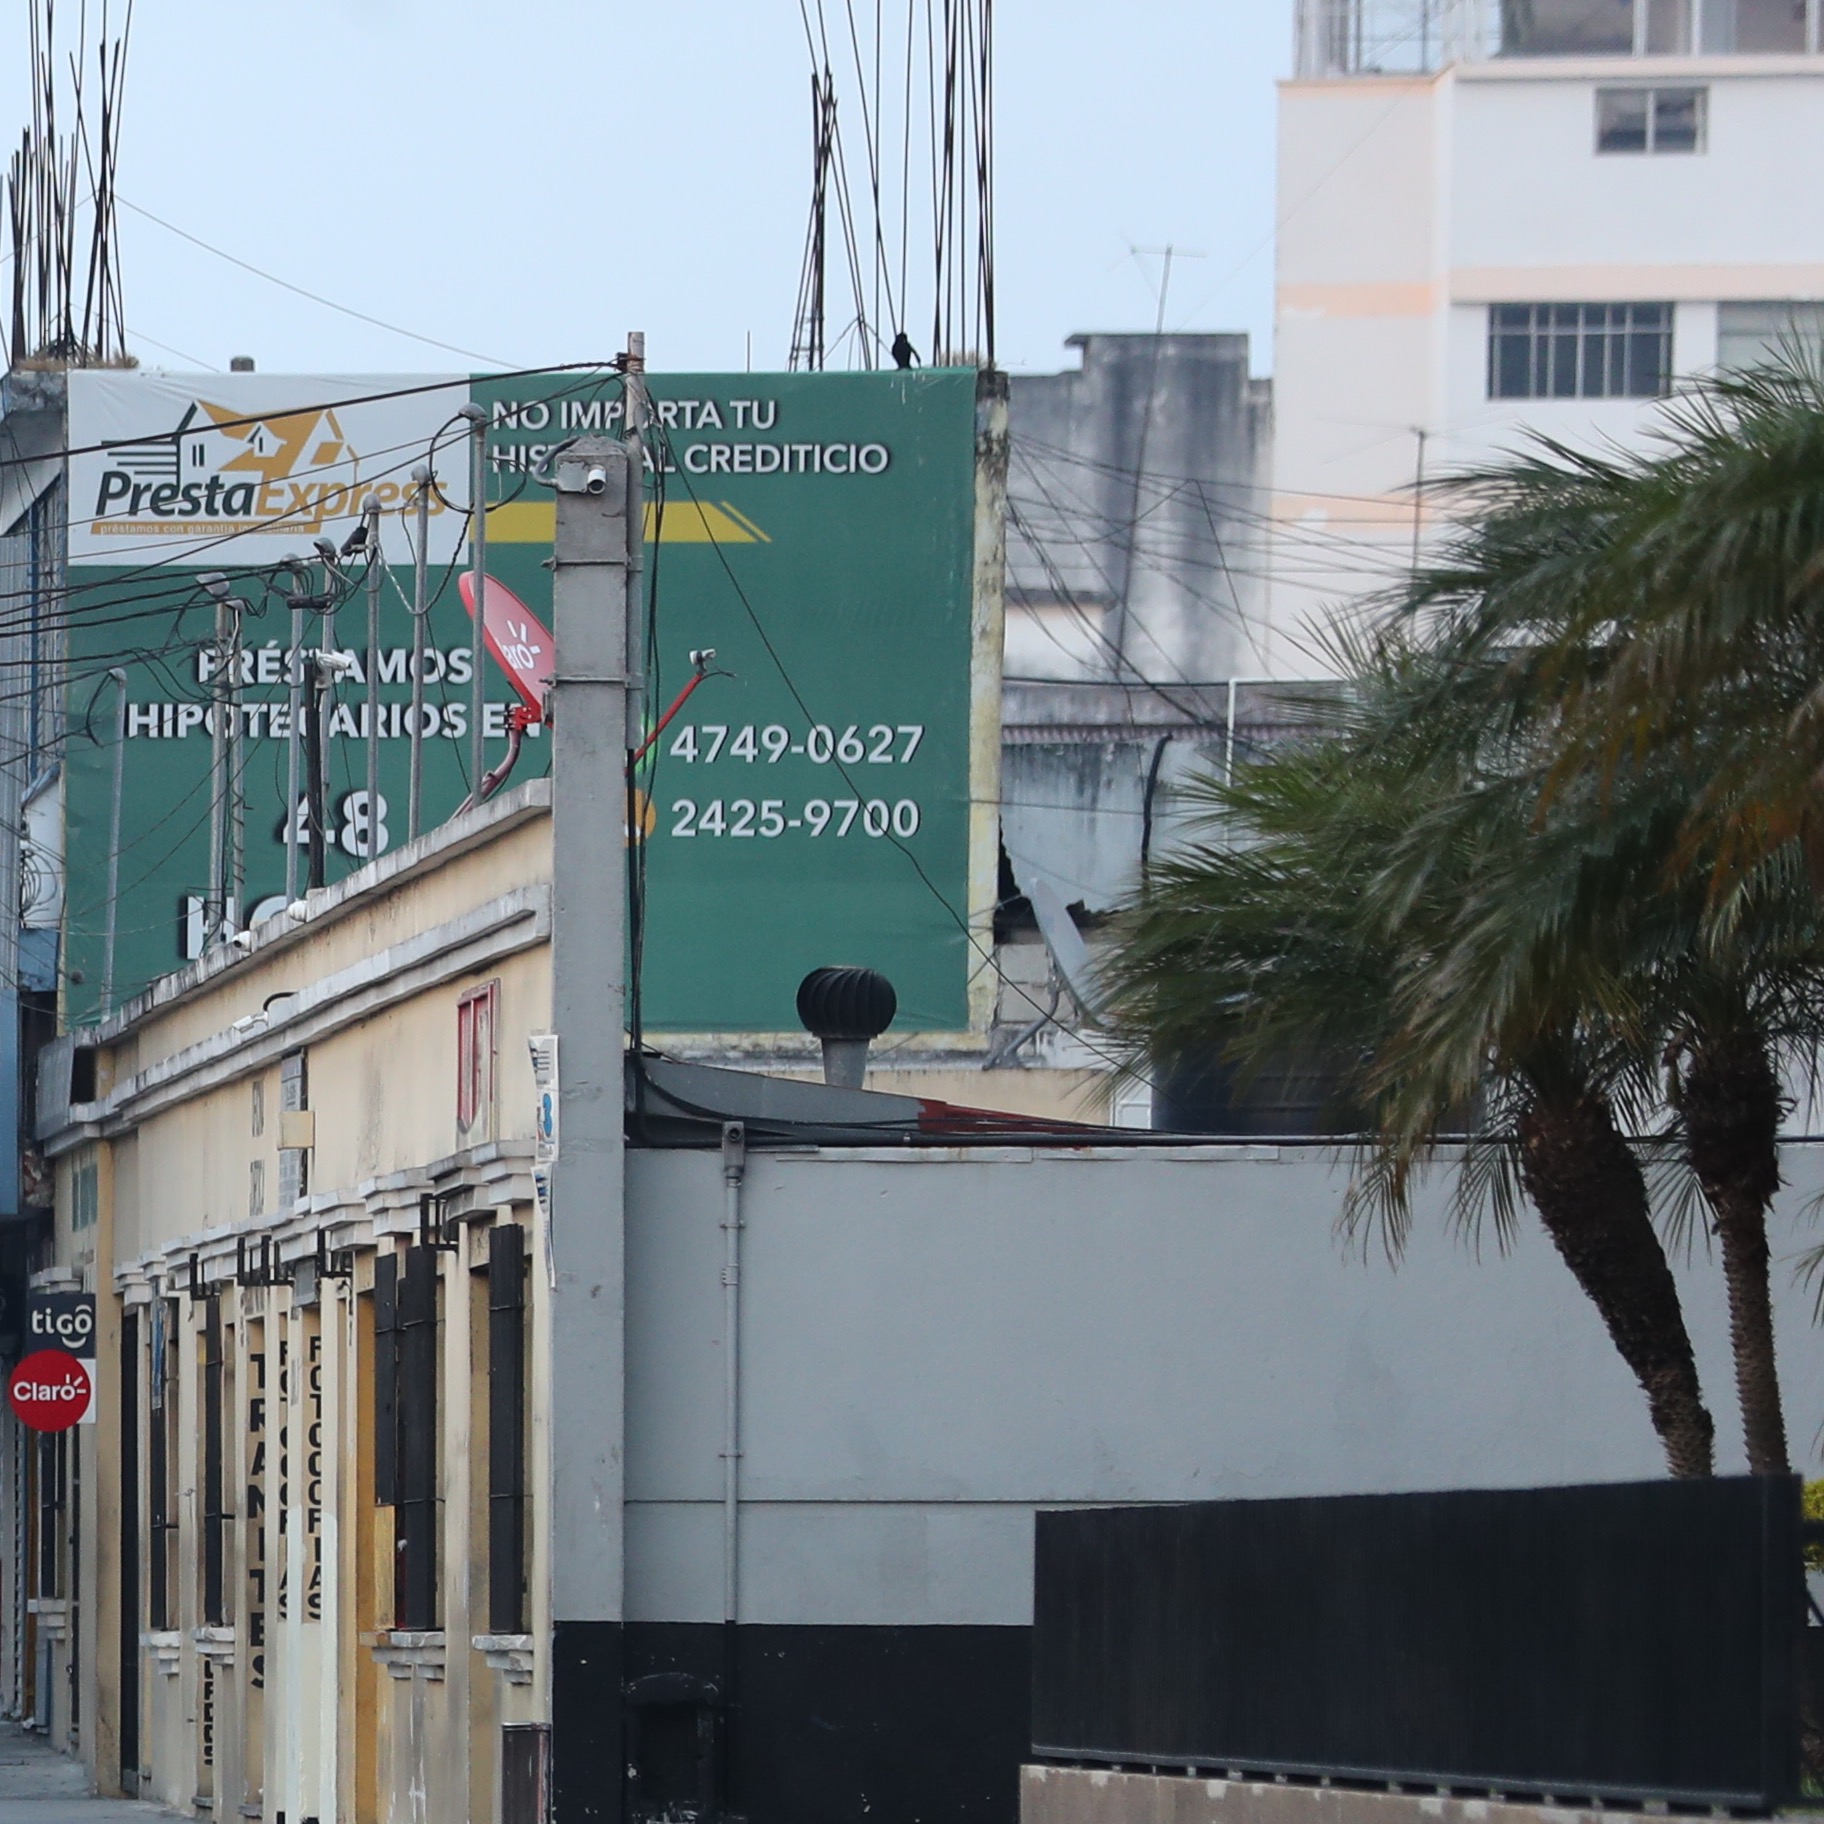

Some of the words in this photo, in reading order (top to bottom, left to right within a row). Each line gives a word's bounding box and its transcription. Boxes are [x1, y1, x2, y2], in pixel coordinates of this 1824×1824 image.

[491, 400, 550, 431] NO
[559, 400, 723, 431] IMPRTA
[729, 400, 777, 431] TU
[491, 444, 676, 474] HISAL
[683, 443, 889, 474] CREDITICIO
[94, 470, 448, 525] PrestaExpress
[163, 523, 184, 533] con
[198, 639, 473, 685] PRÉSAMOS
[669, 724, 925, 764] 4749-0627
[282, 790, 390, 858] 48
[670, 799, 922, 838] 2425-9700
[31, 1305, 93, 1348] tigo
[13, 1378, 80, 1402] Claro
